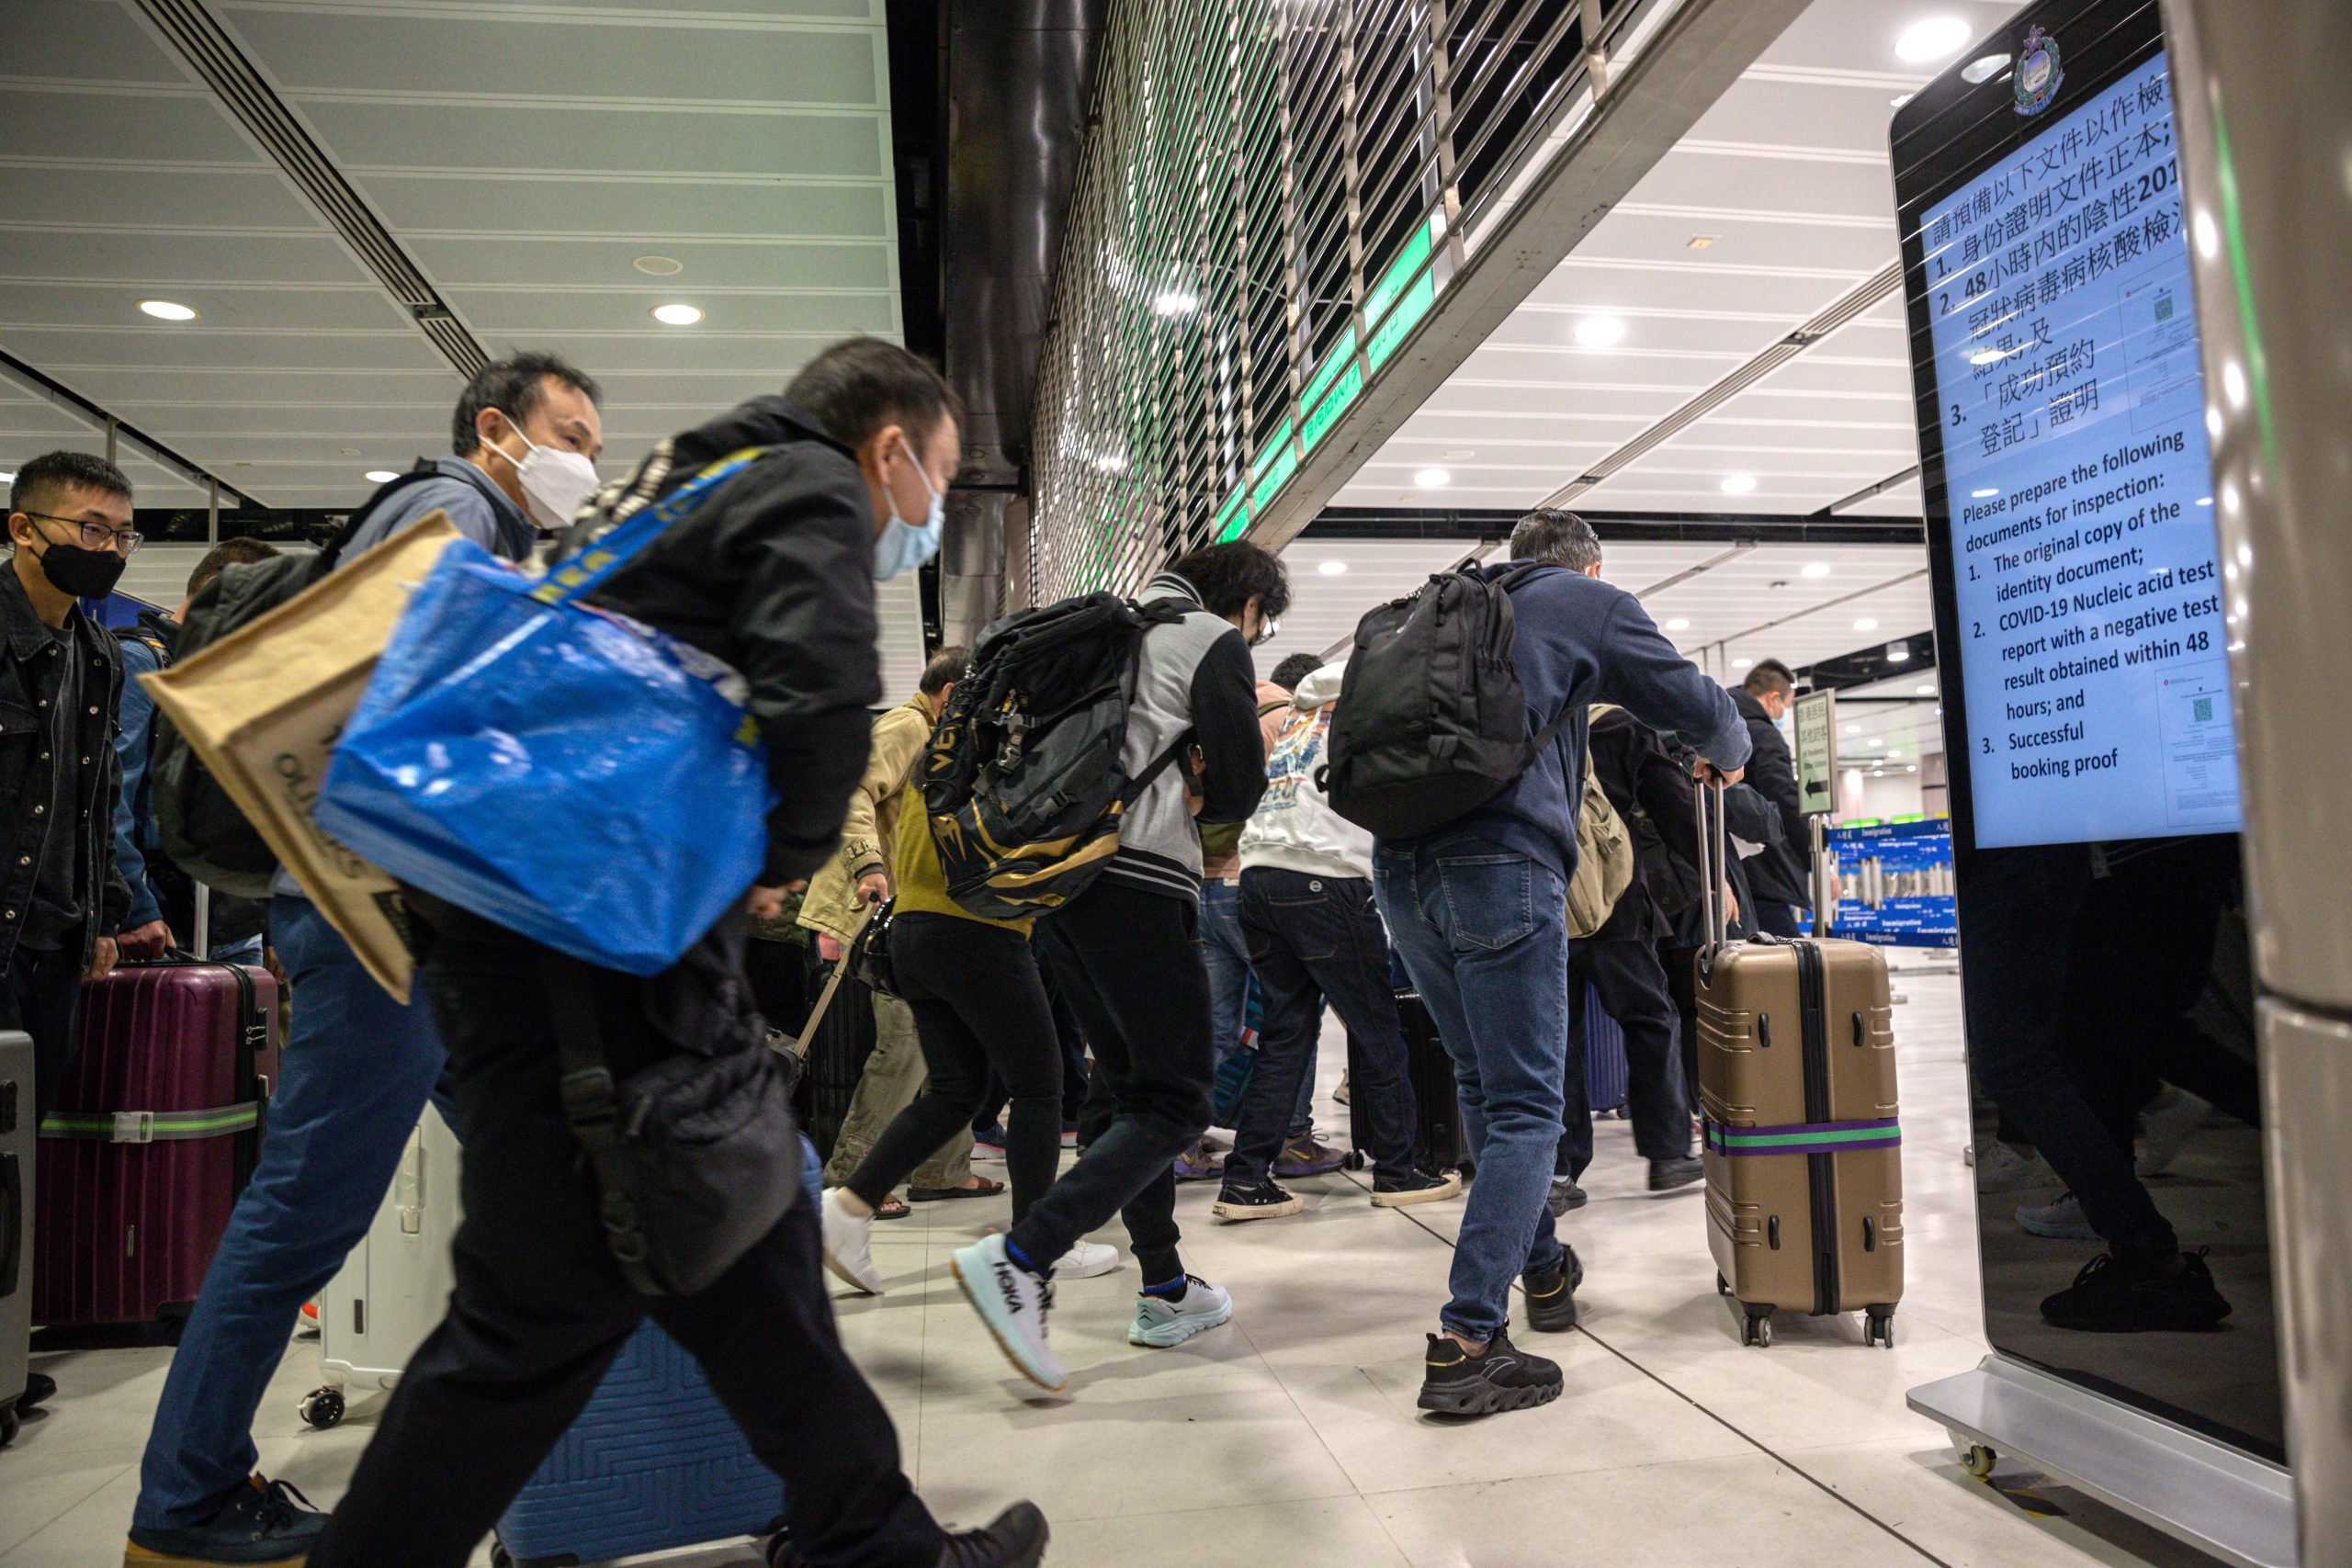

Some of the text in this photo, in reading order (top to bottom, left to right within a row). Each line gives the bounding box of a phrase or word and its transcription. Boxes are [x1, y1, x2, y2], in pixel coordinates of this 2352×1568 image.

[1932, 74, 2170, 246] 請預備以下文件以作檢
[1936, 256, 1952, 278] 1.
[1939, 292, 1956, 316] 2.
[1951, 403, 1967, 426] 3.
[1962, 431, 2185, 525] Please prepare the following
[1966, 473, 2165, 553] documents for inspection:
[1969, 502, 2181, 581] 1. The original copy of the
[1973, 559, 2215, 638] 2. COVID-19 Nucleic acid test
[1996, 547, 2143, 603] identity document;
[2002, 594, 2220, 662] report with a negative test
[2004, 630, 2210, 691] result obtained within 48
[2007, 688, 2085, 721] hours; and
[1982, 720, 2084, 754] 3. Successful
[2011, 748, 2118, 780] booking proof
[992, 1261, 1023, 1314] HOKA
